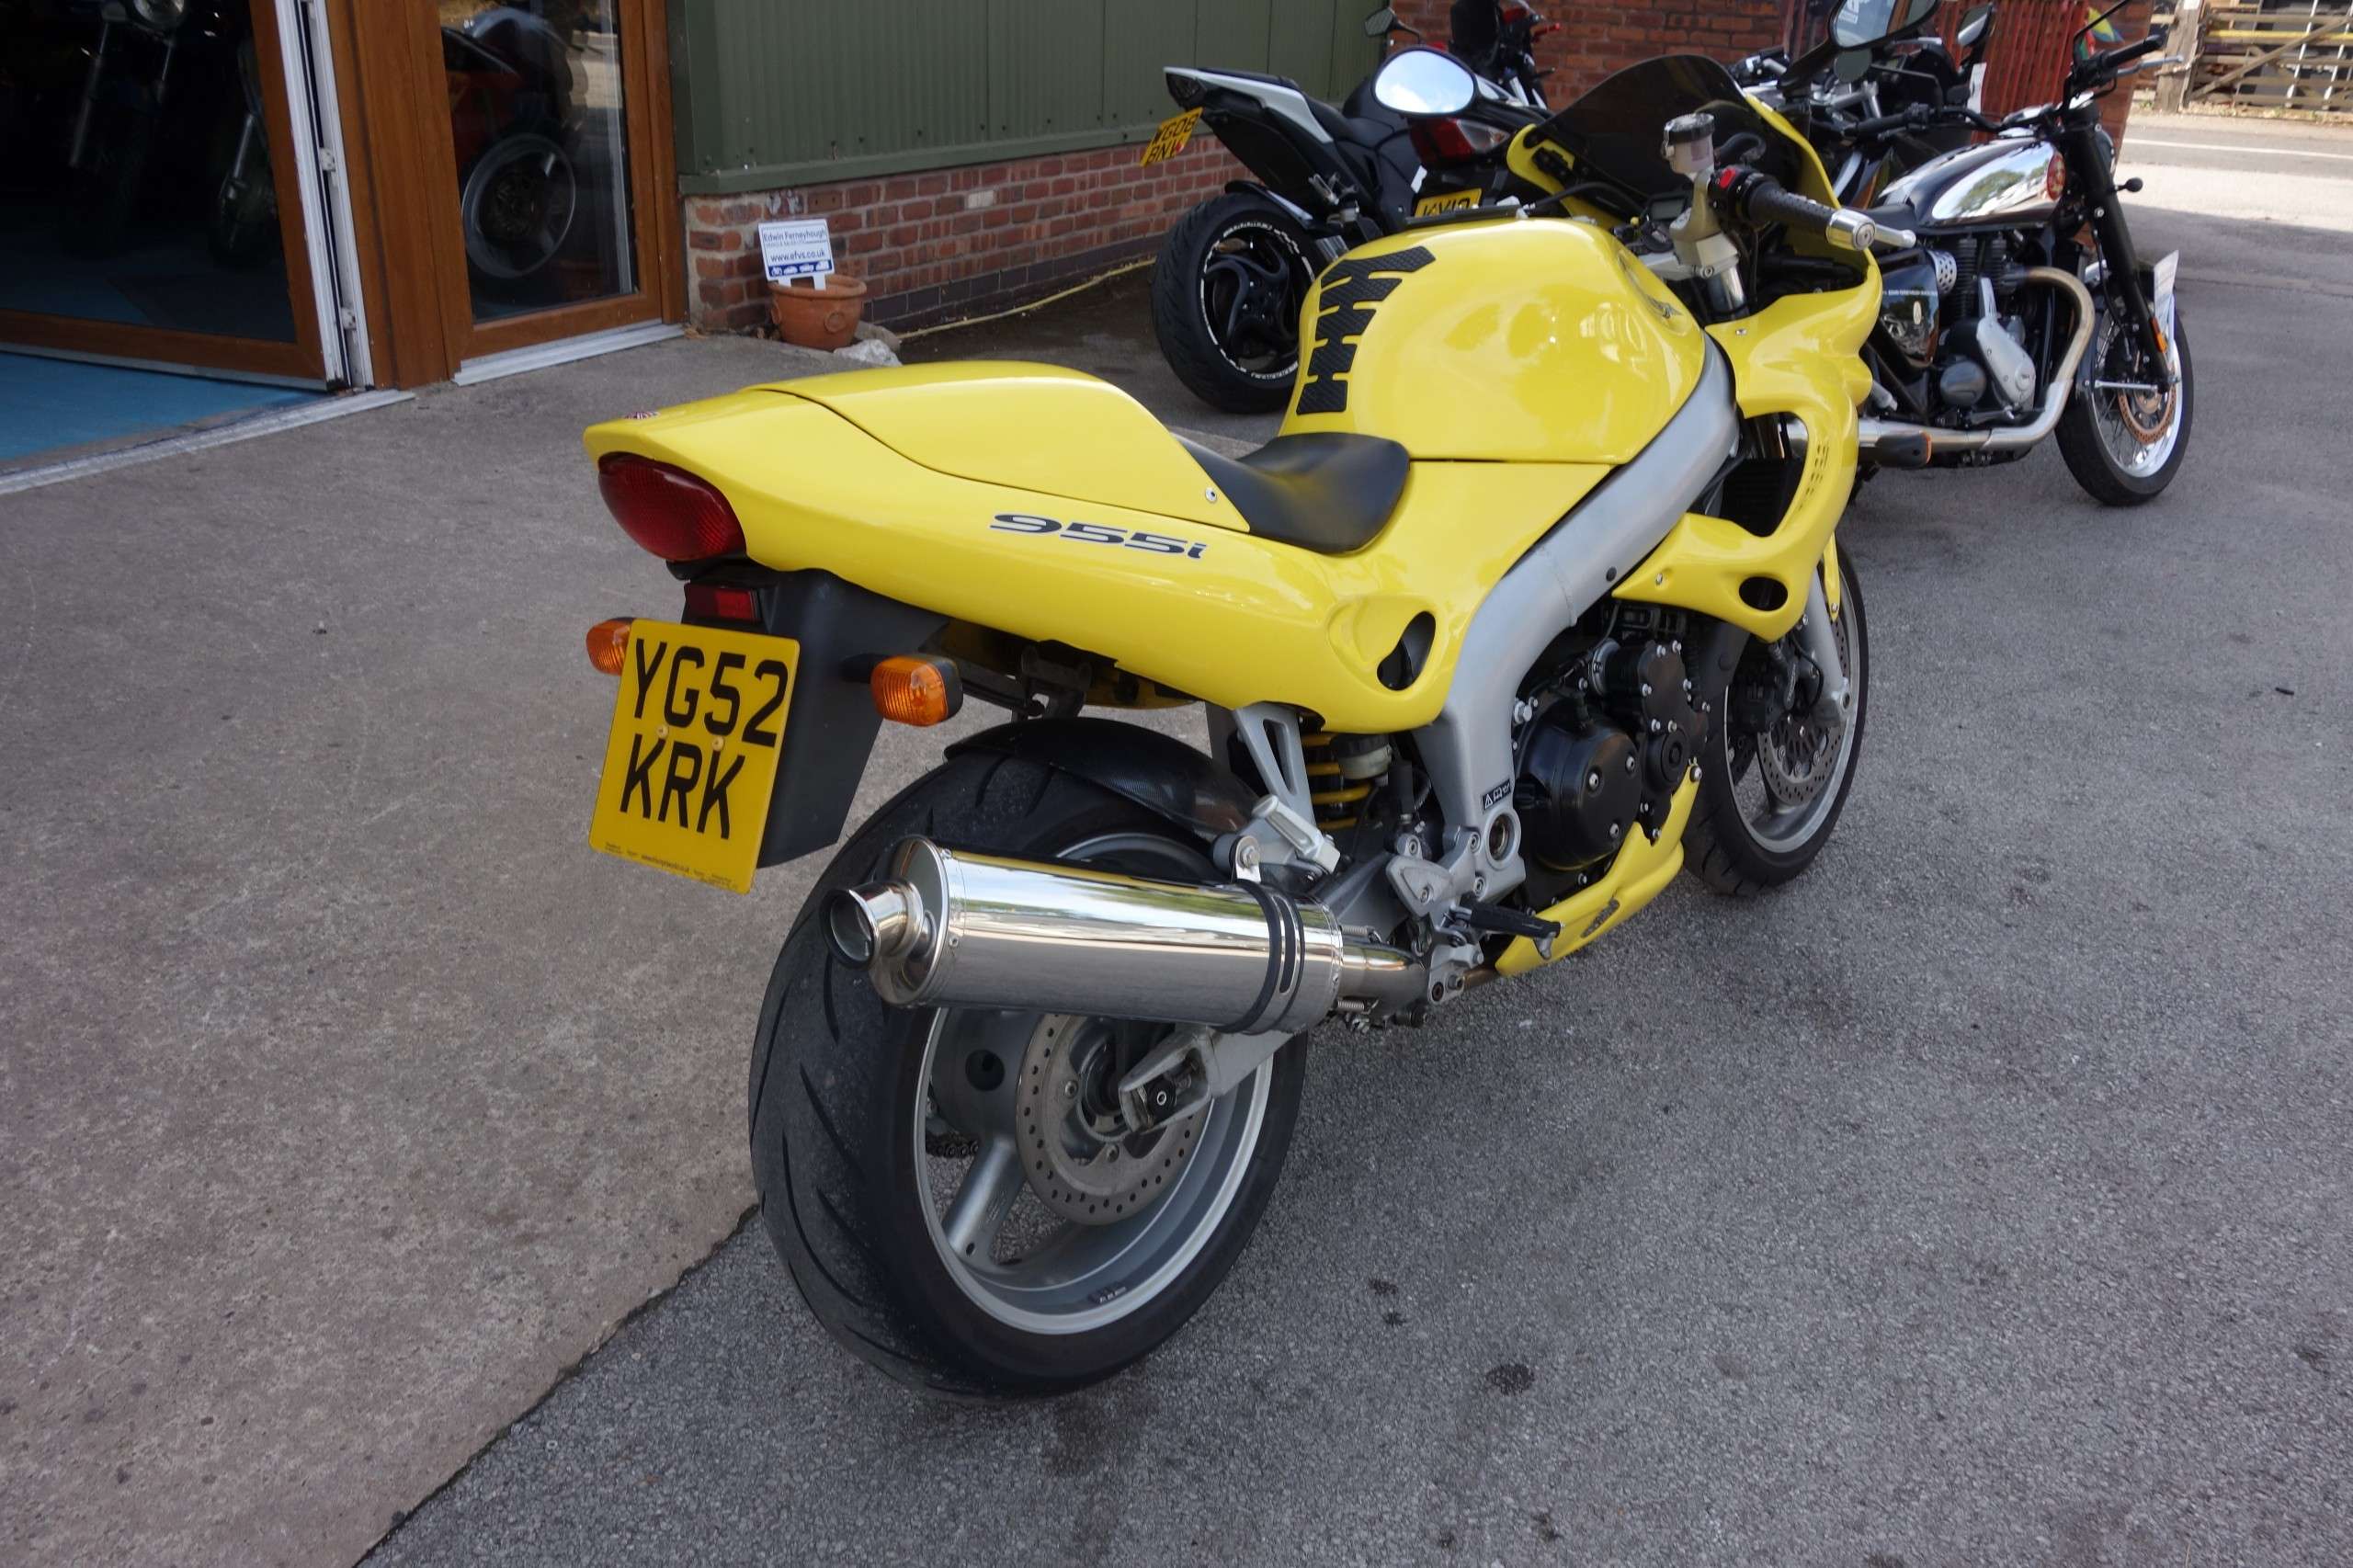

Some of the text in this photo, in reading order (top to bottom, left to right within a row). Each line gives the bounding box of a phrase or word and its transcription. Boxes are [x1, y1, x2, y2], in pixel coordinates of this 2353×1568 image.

[763, 232, 784, 242] Edwin
[770, 249, 824, 261] www.efvs.co.uk
[990, 514, 1208, 560] 955i
[634, 638, 789, 749] YG52
[620, 733, 745, 840] KRK
